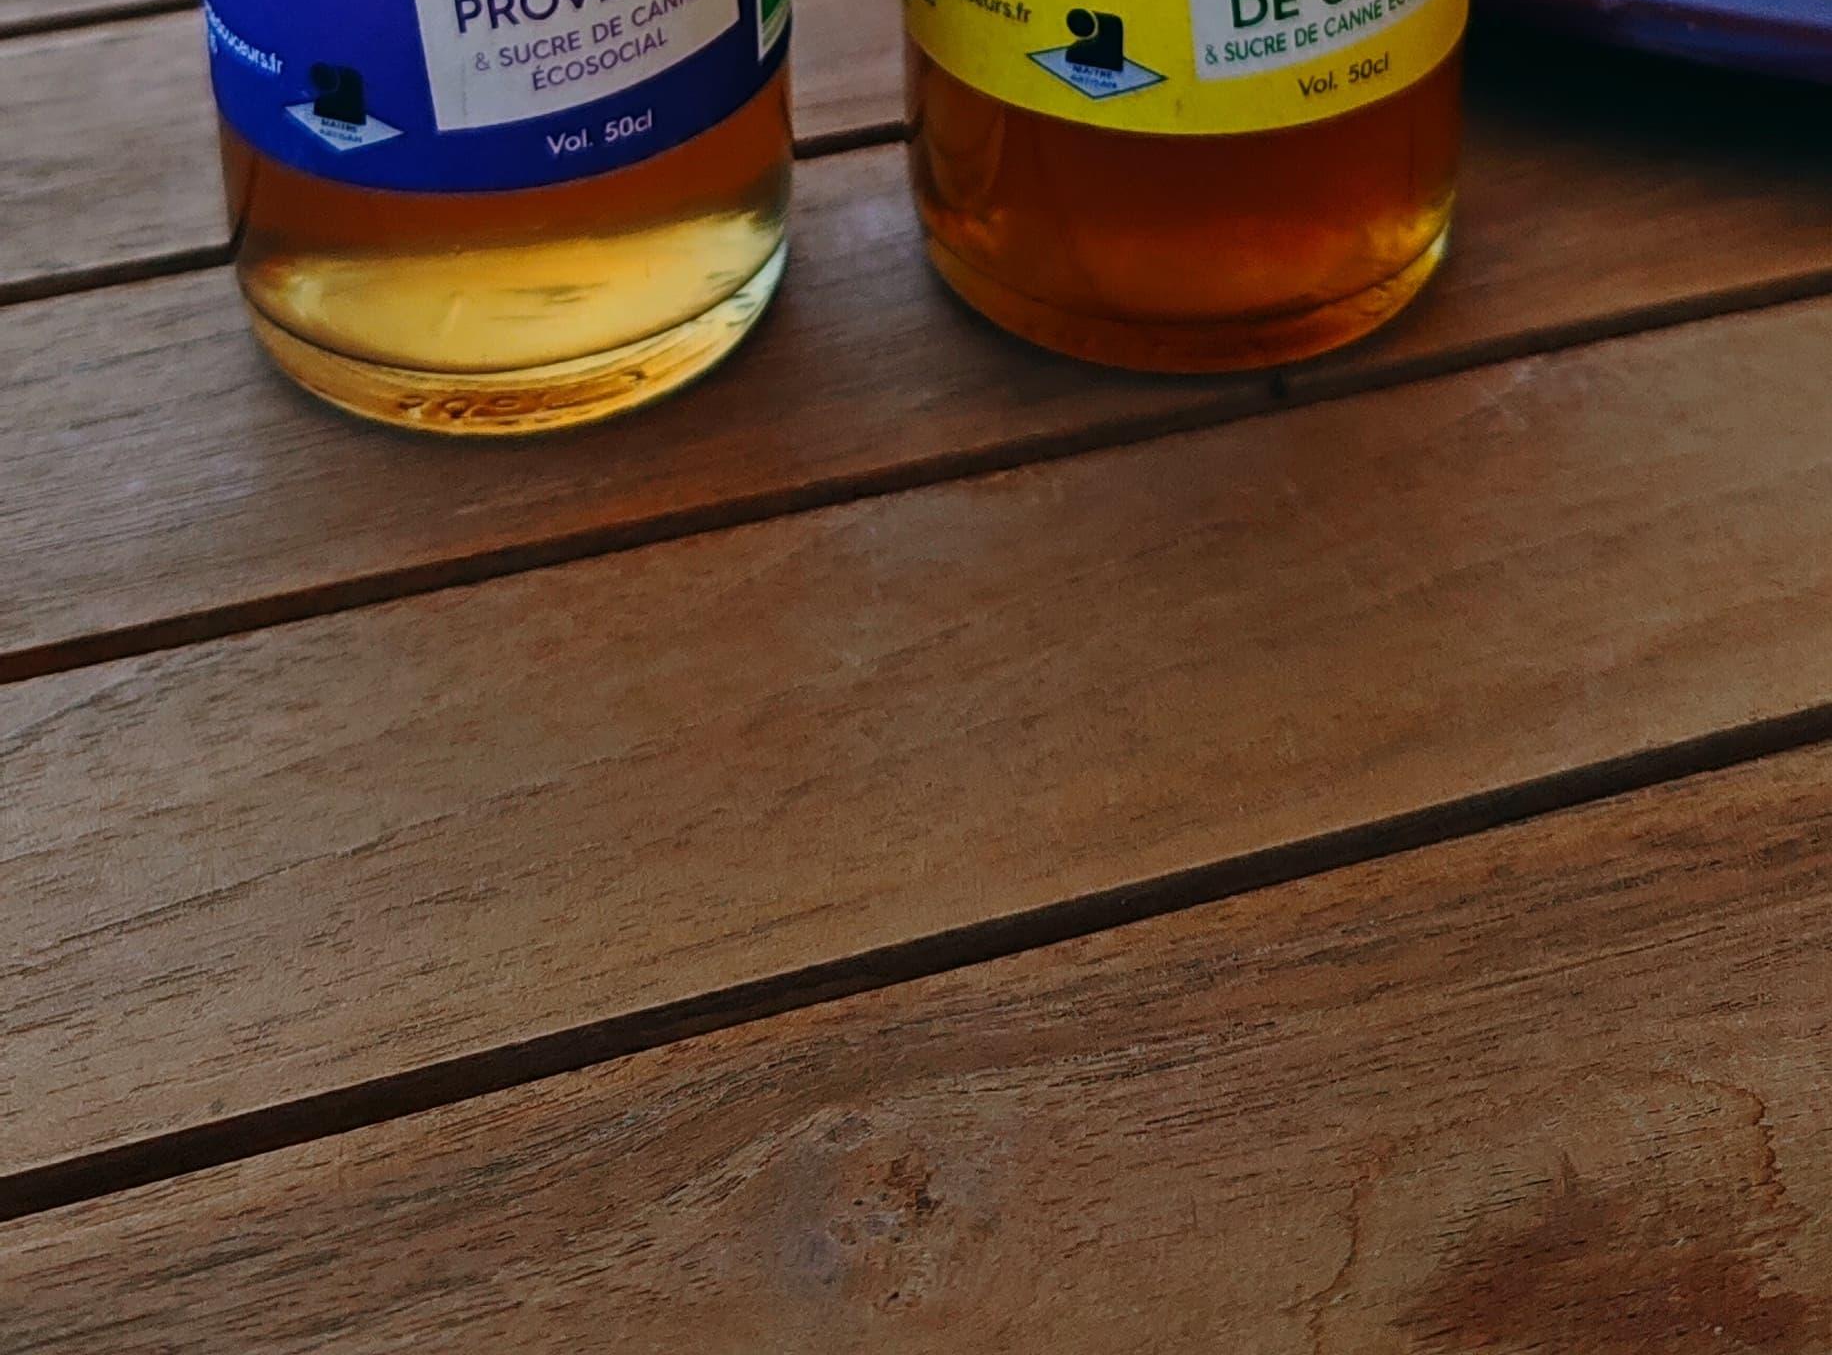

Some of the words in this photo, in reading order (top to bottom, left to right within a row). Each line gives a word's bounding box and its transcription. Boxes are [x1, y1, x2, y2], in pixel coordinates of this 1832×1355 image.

[474, 49, 492, 72] &
[499, 30, 583, 69] SUCRE
[592, 16, 622, 43] DE
[531, 25, 669, 92] ÉCOSOCIAL
[1205, 45, 1219, 66] &
[1224, 31, 1287, 65] SUCRE
[1294, 23, 1319, 48] DE
[1298, 73, 1339, 98] Vol.
[1348, 53, 1390, 86] 50cl
[547, 129, 594, 156] Vol.
[604, 108, 654, 145] 50cl
